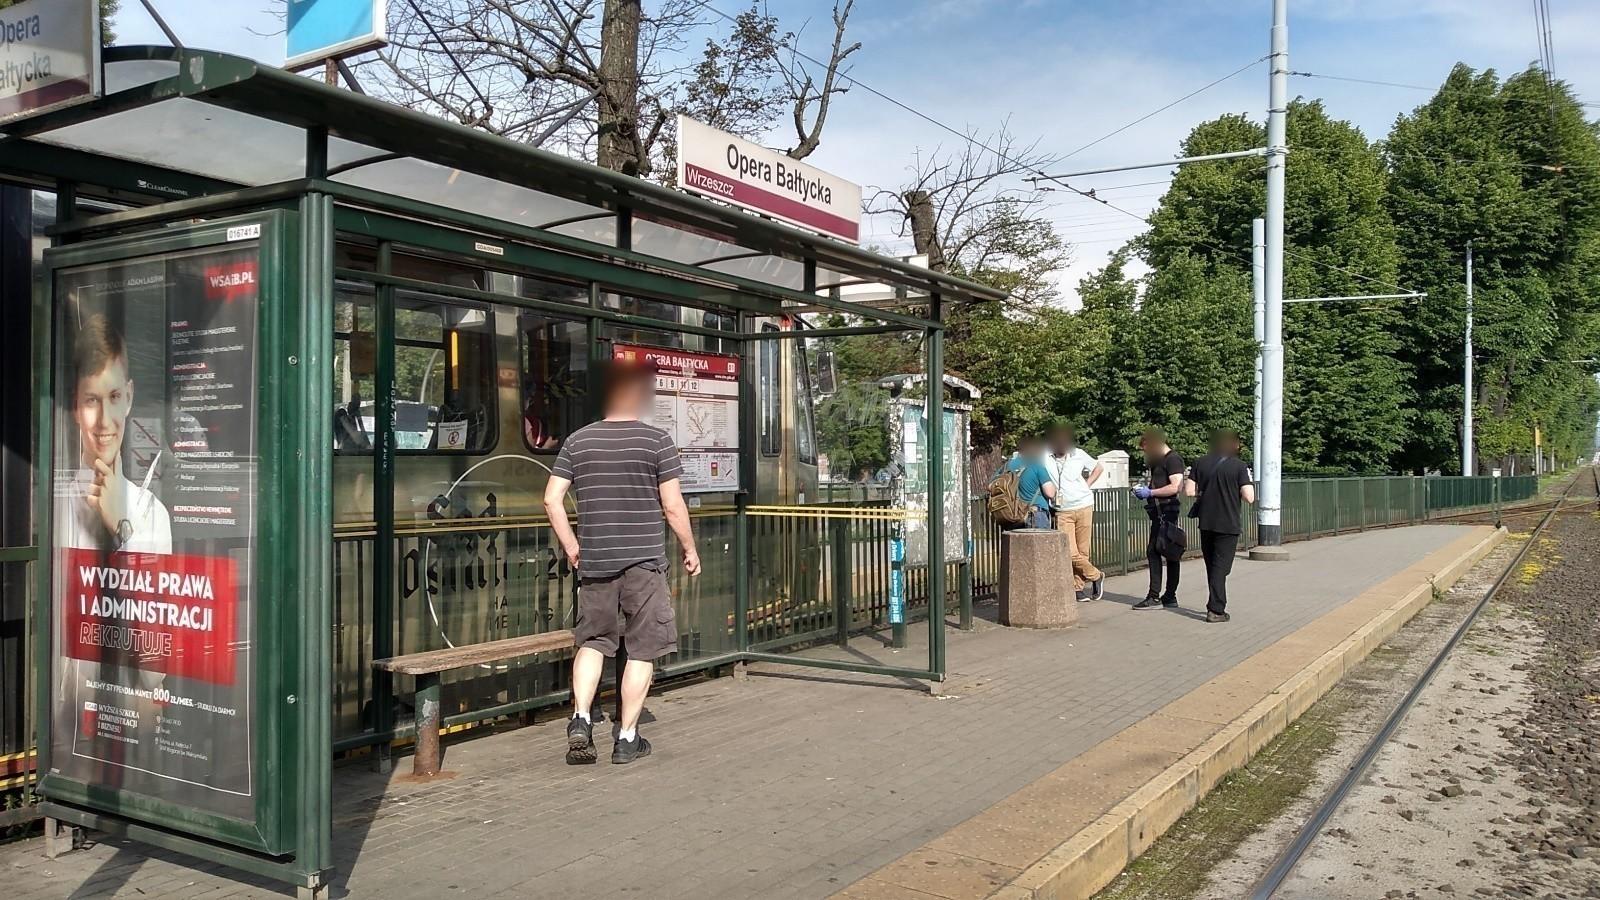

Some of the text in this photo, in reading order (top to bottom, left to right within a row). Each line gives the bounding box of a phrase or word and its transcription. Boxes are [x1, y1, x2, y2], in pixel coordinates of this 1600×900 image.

[0, 51, 51, 93] ałtycka
[686, 166, 735, 197] Wrzeszcz
[727, 143, 832, 205] Opera Bałtycka
[228, 228, 252, 240] 016741
[210, 272, 255, 288] WSAiB.PL
[672, 356, 709, 370] BAŁTYCKA
[691, 381, 697, 390] 12
[79, 565, 214, 600] WYDZIAŁ PRAWA
[80, 594, 213, 632] I ADMINISTRACJI
[79, 622, 172, 657] REKRUTUJE
[86, 679, 106, 690] DAJEMY
[106, 683, 135, 696] STYPENDIA
[153, 687, 170, 703] 800
[98, 703, 140, 719] WYŻSZA SZKOŁA
[98, 713, 138, 729] ADMINISTRACJI
[101, 723, 122, 733] BIZNESU
